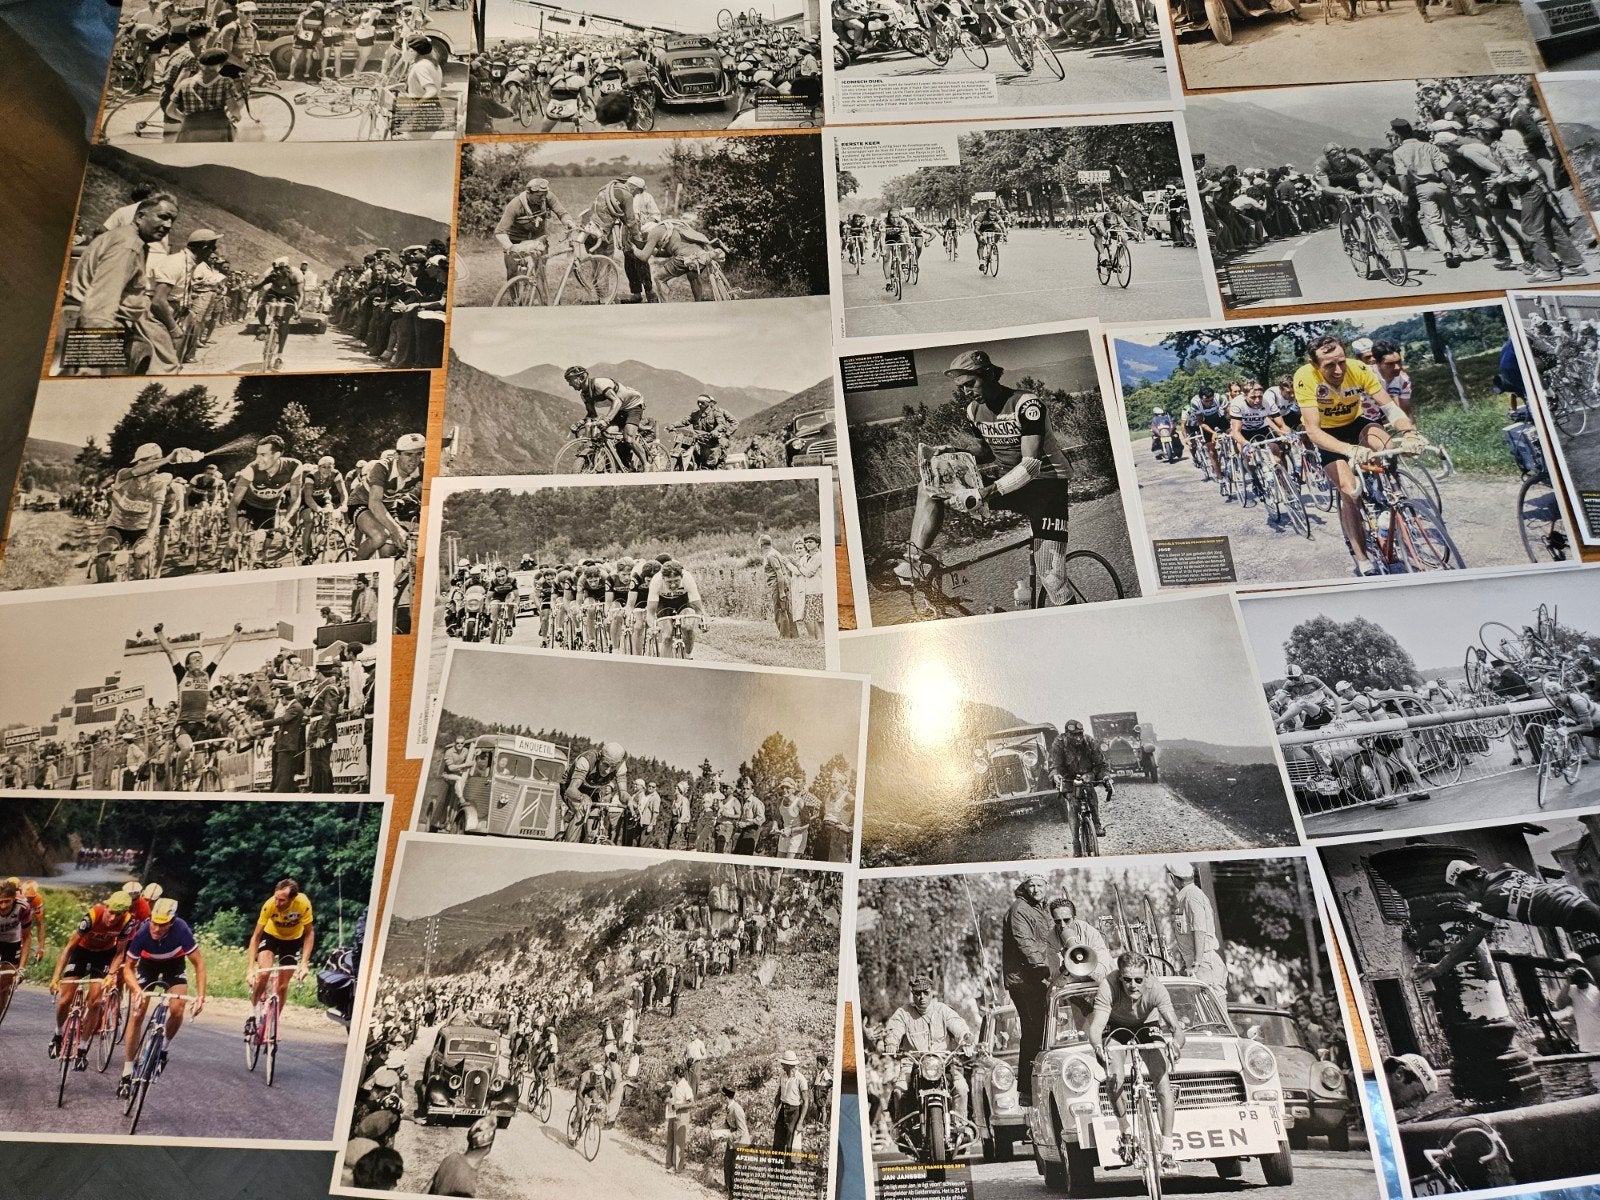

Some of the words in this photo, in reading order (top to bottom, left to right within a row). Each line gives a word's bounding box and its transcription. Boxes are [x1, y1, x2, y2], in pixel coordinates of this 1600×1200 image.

[606, 83, 616, 91] 23
[550, 106, 564, 115] 22
[518, 740, 553, 755] ANQUETIL
[767, 1157, 784, 1165] STIJL
